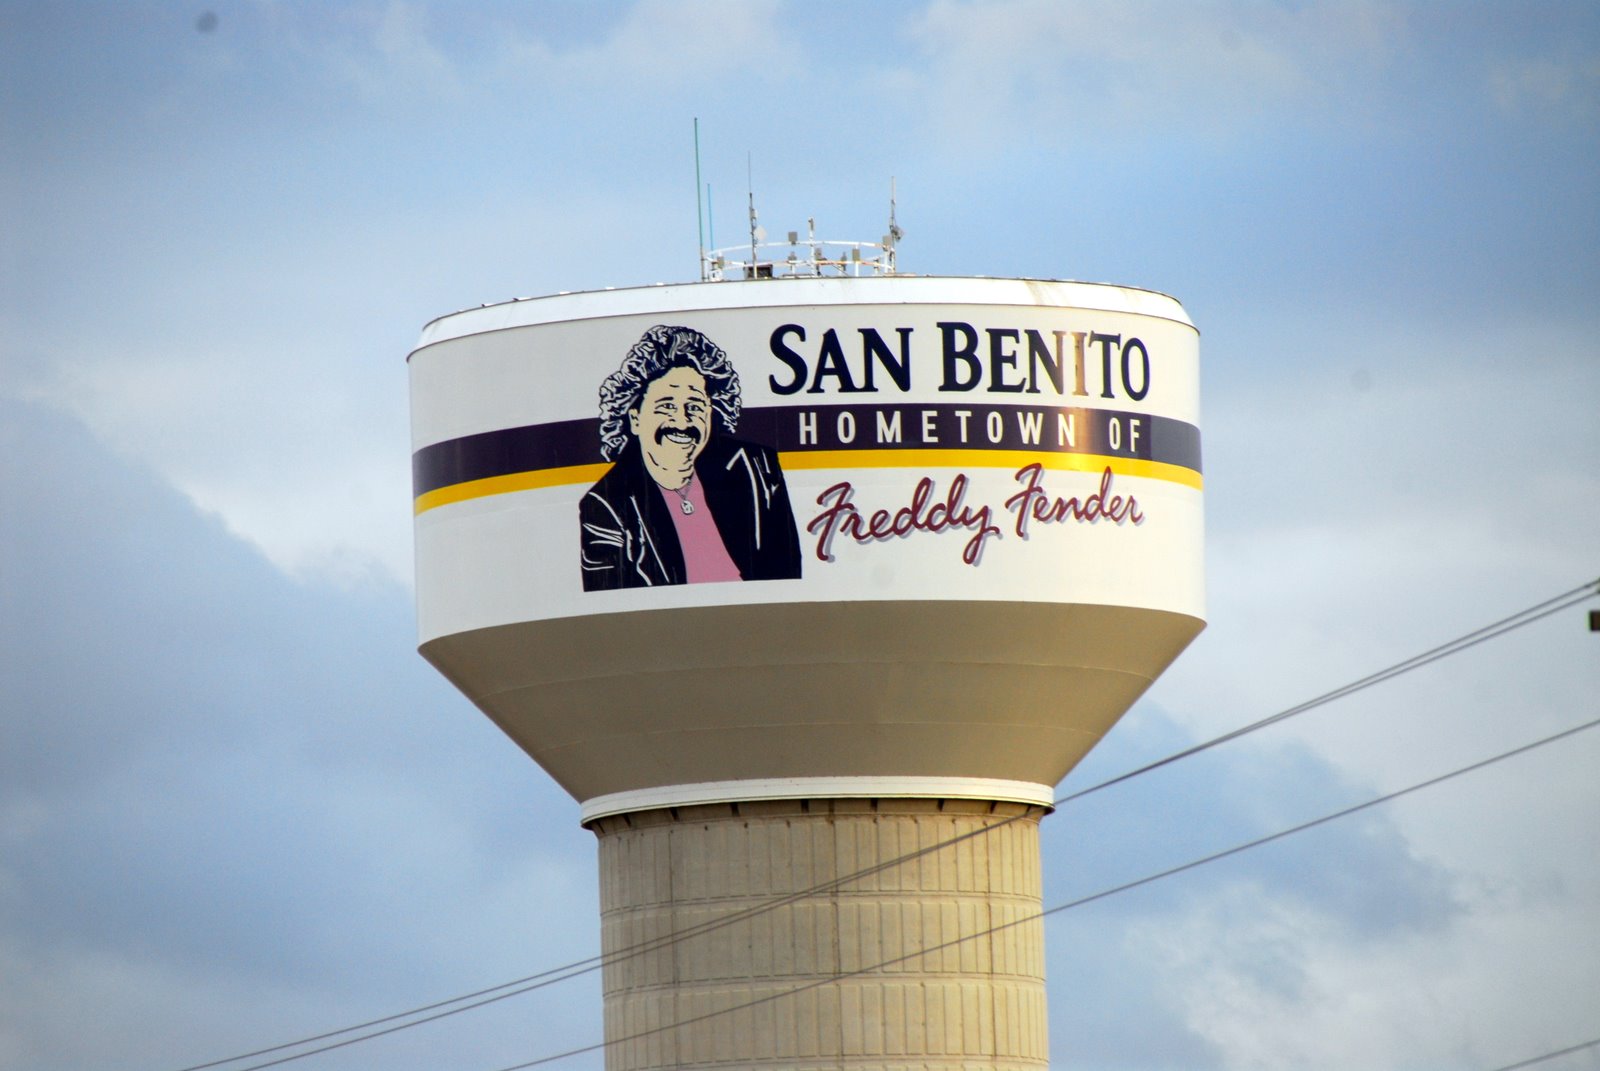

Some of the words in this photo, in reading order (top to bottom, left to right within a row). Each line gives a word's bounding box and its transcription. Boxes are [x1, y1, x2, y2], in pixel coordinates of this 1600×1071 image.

[769, 323, 913, 395] SAN
[936, 321, 1151, 401] BENITO
[799, 410, 1075, 447] HOMETOWN
[1109, 418, 1140, 452] OF
[807, 473, 1001, 566] Freddy
[1005, 463, 1144, 538] Fender
